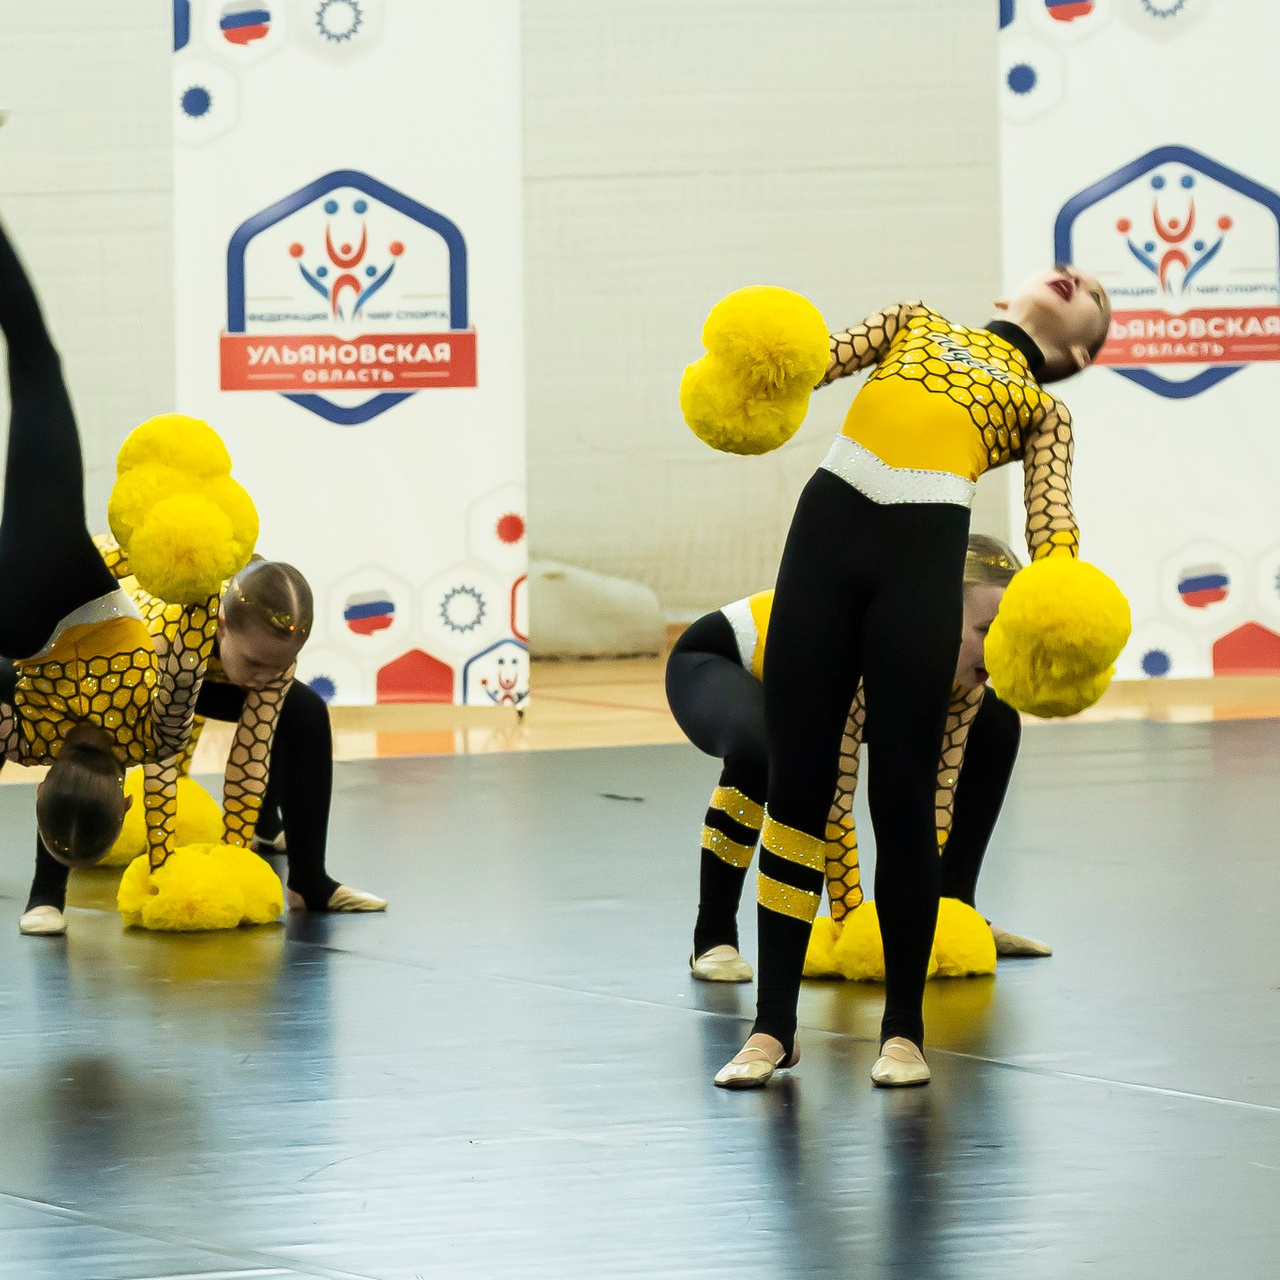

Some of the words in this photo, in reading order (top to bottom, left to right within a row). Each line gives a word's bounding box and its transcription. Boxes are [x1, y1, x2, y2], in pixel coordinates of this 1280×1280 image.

[1109, 316, 1280, 339] ЬЯНОВСКАЯ
[246, 343, 451, 365] УЛЬЯНОВСКАЯ
[1131, 342, 1225, 357] ОБЛАСТЬ
[302, 369, 395, 383] ОБЛАСТЬ
